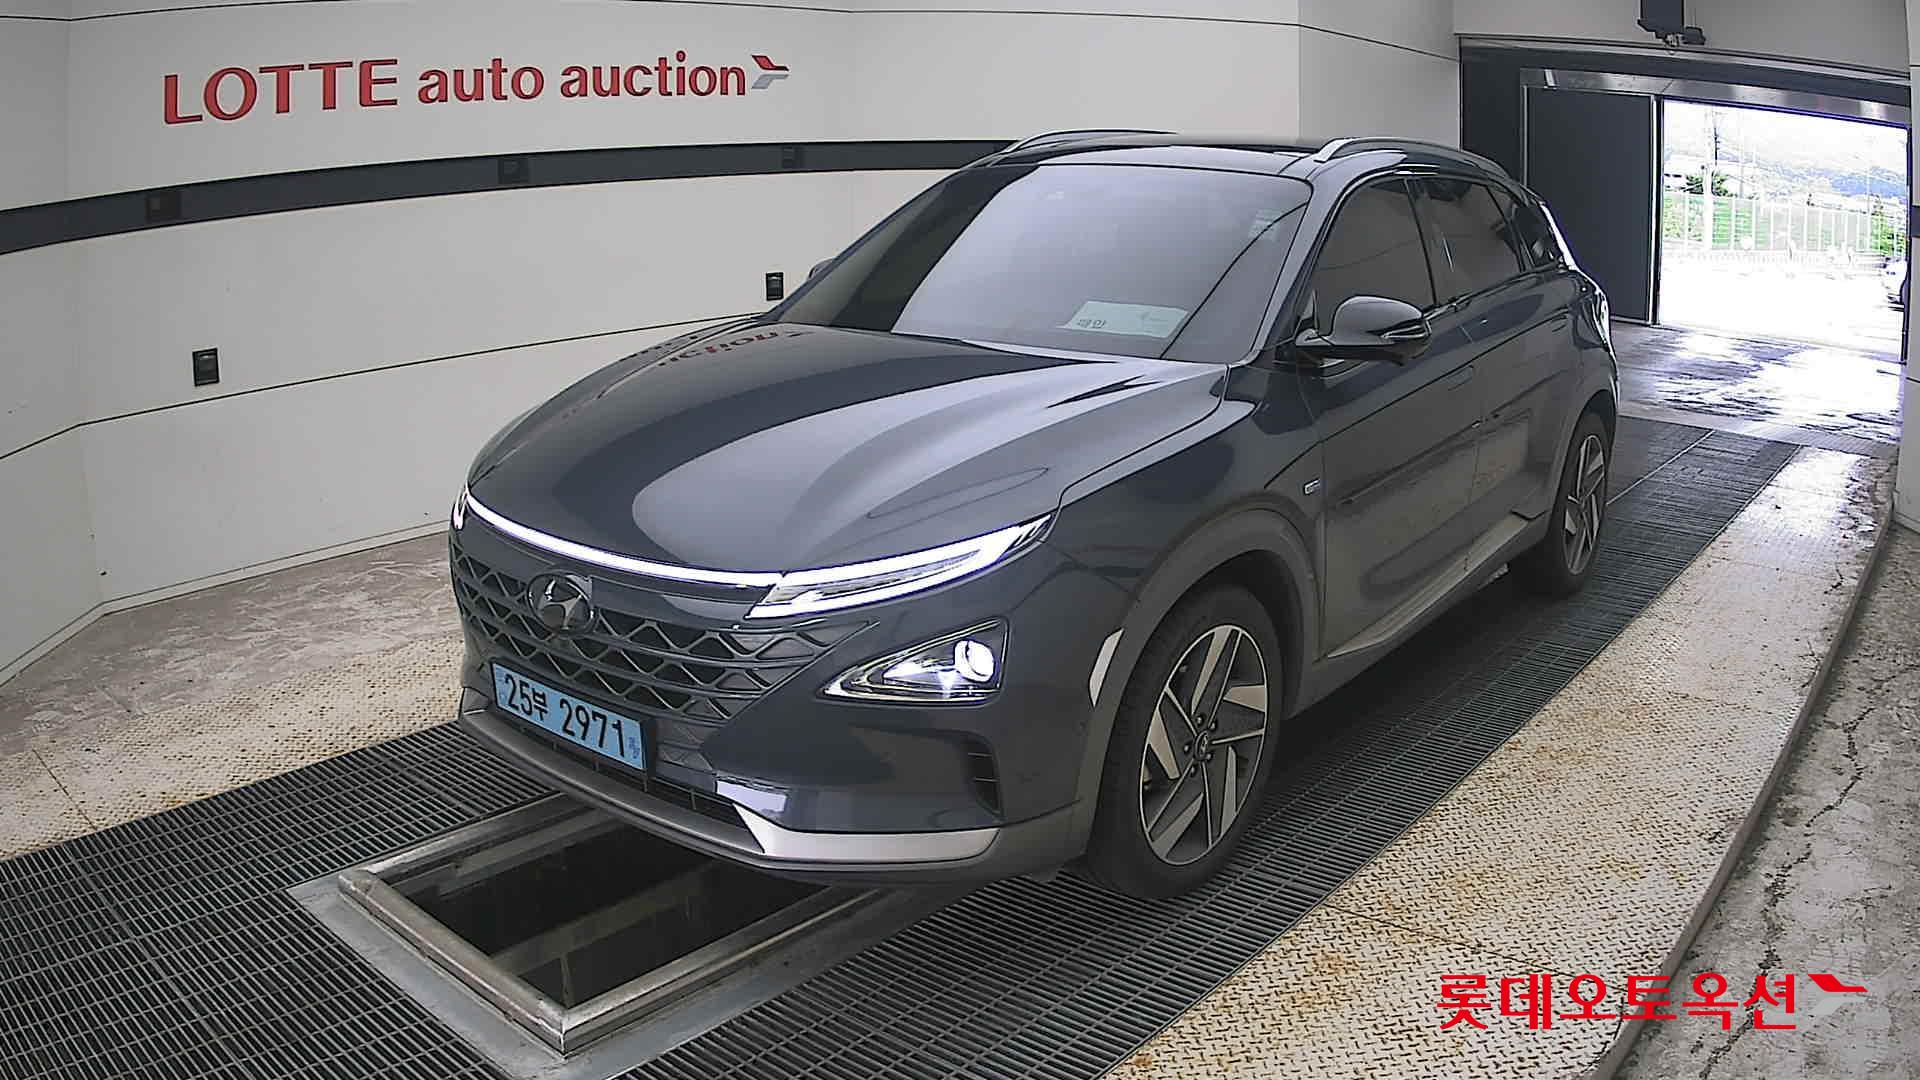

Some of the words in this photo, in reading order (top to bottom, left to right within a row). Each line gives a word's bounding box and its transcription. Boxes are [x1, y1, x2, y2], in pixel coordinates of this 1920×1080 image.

[163, 58, 399, 125] LOTTE
[417, 57, 546, 104] auto
[560, 50, 747, 98] auction
[505, 673, 548, 721] 25부
[560, 697, 625, 758] 2971
